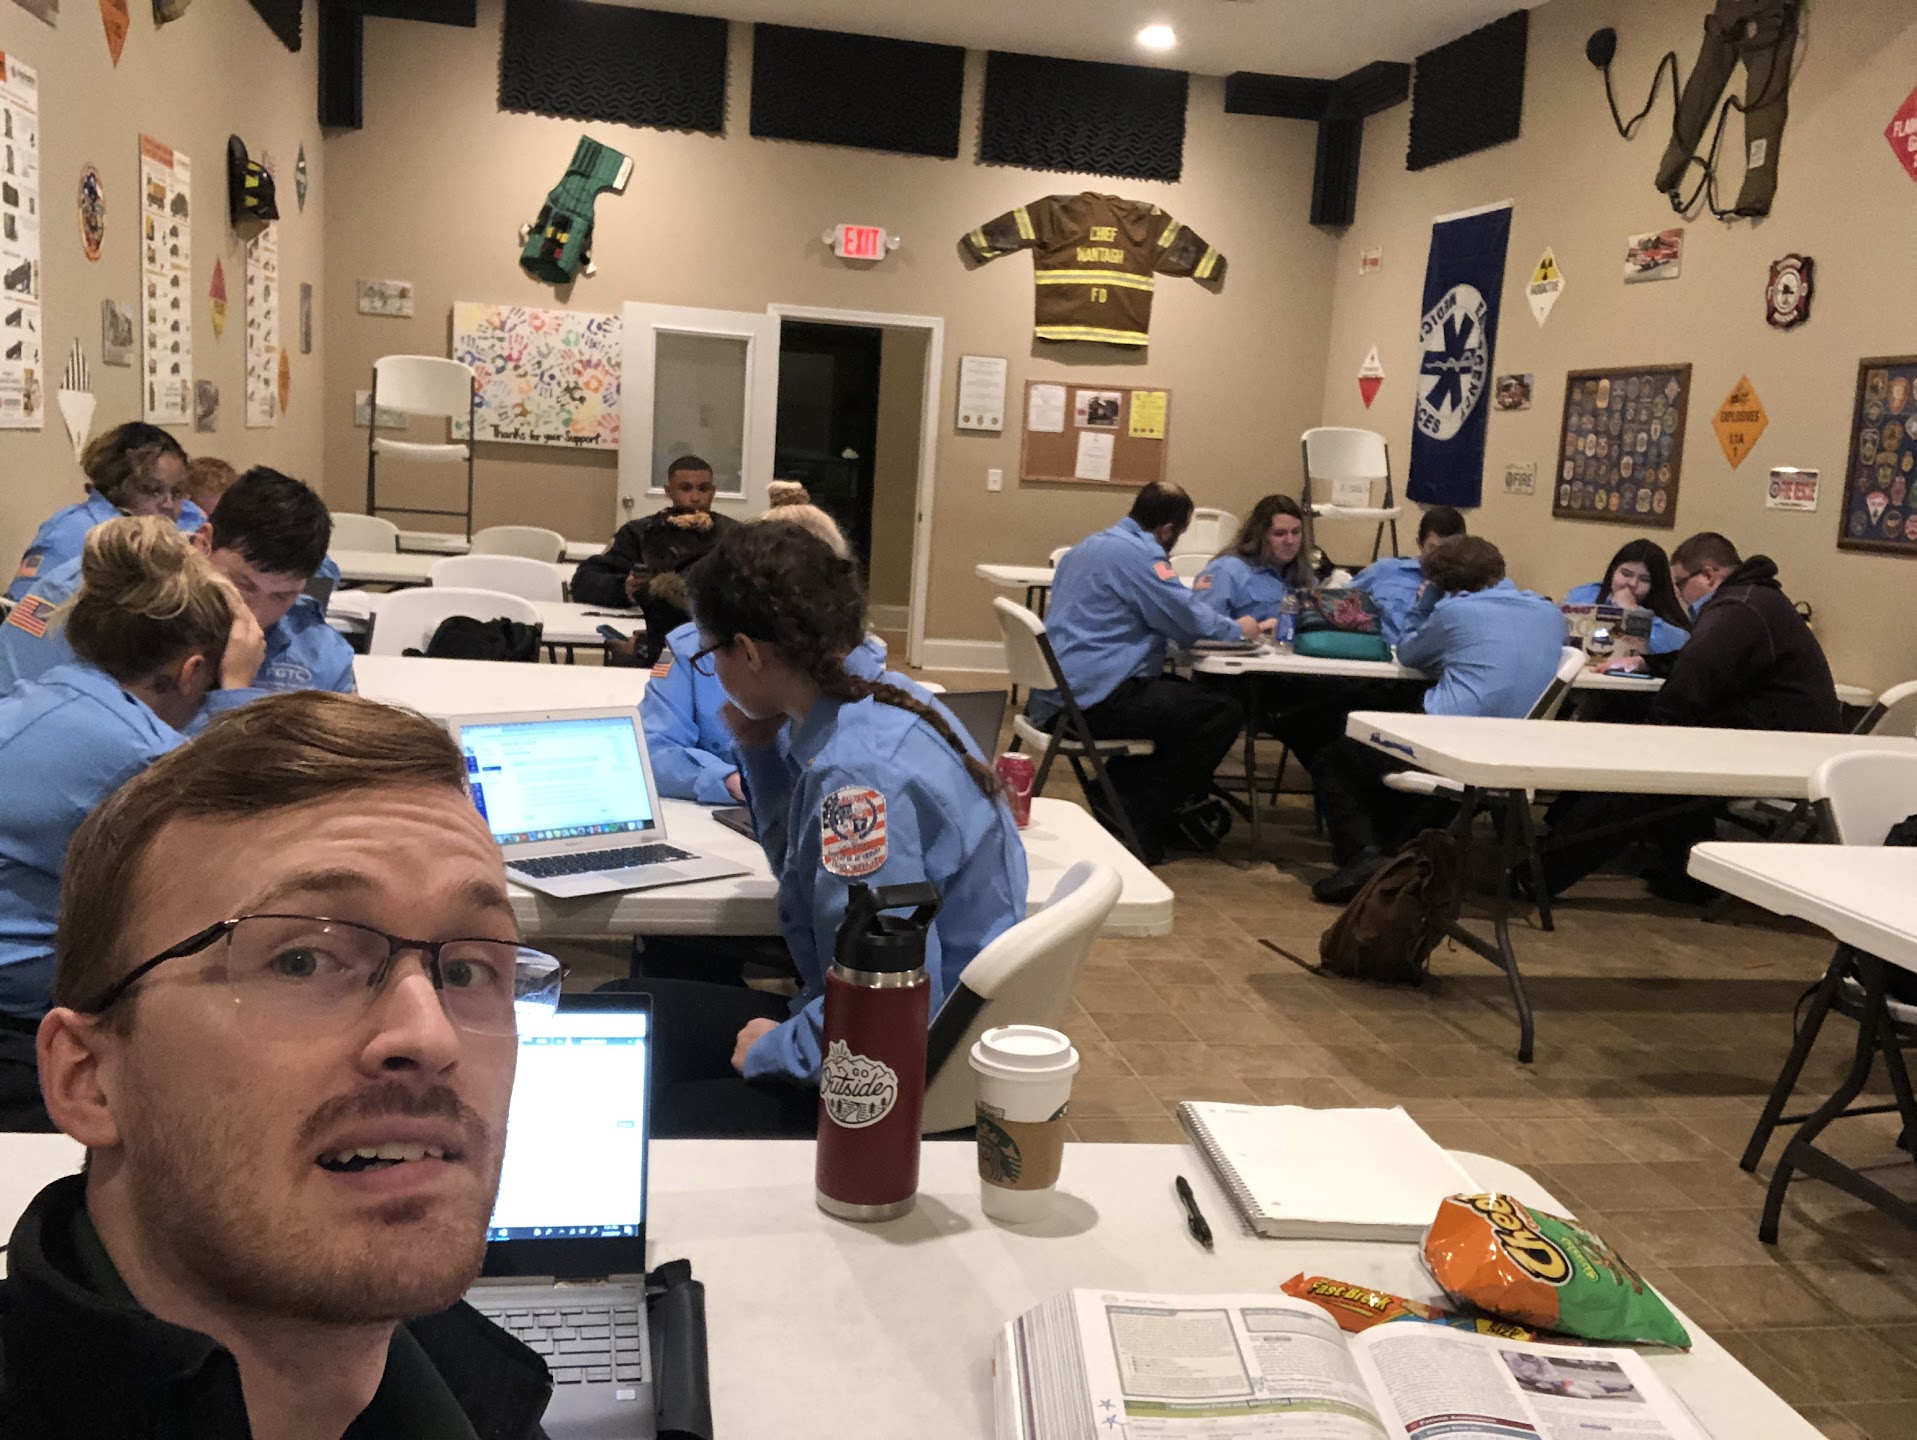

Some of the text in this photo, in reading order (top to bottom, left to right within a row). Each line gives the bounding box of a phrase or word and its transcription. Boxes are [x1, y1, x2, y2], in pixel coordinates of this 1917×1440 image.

[844, 226, 880, 257] EXIT
[1089, 226, 1118, 242] CHIEF
[490, 424, 601, 446] Thanks for your Support
[821, 1066, 893, 1098] Outside
[852, 1067, 870, 1079] GO
[1308, 1281, 1346, 1298] Fast
